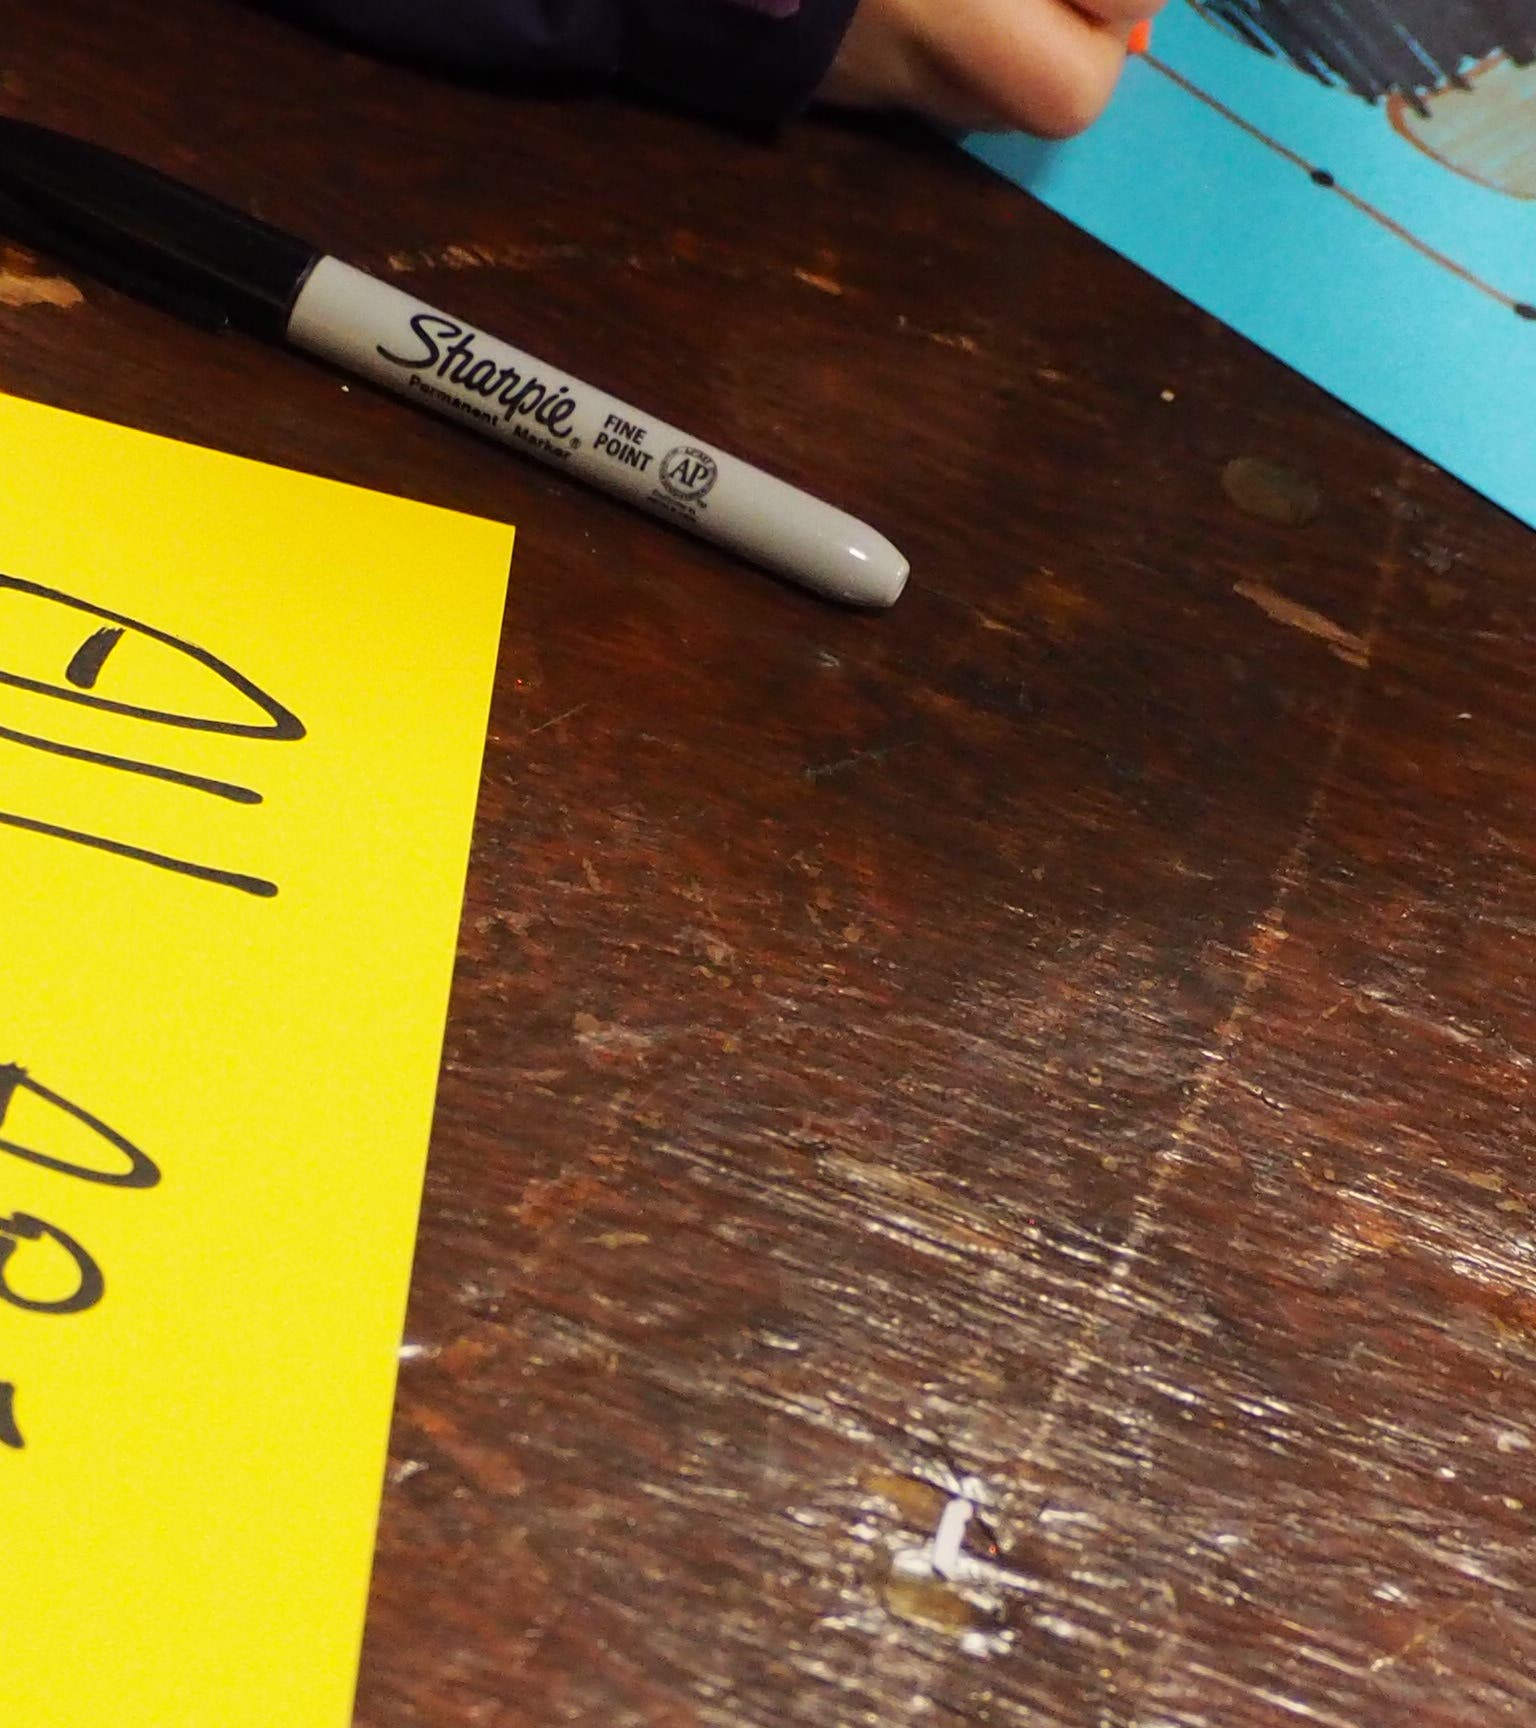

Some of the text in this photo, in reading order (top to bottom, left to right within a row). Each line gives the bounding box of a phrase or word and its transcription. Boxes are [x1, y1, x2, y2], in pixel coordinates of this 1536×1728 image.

[375, 313, 577, 440] Sharpie
[603, 413, 648, 446] FINE
[592, 431, 655, 472] POINT
[669, 457, 710, 489] AP
